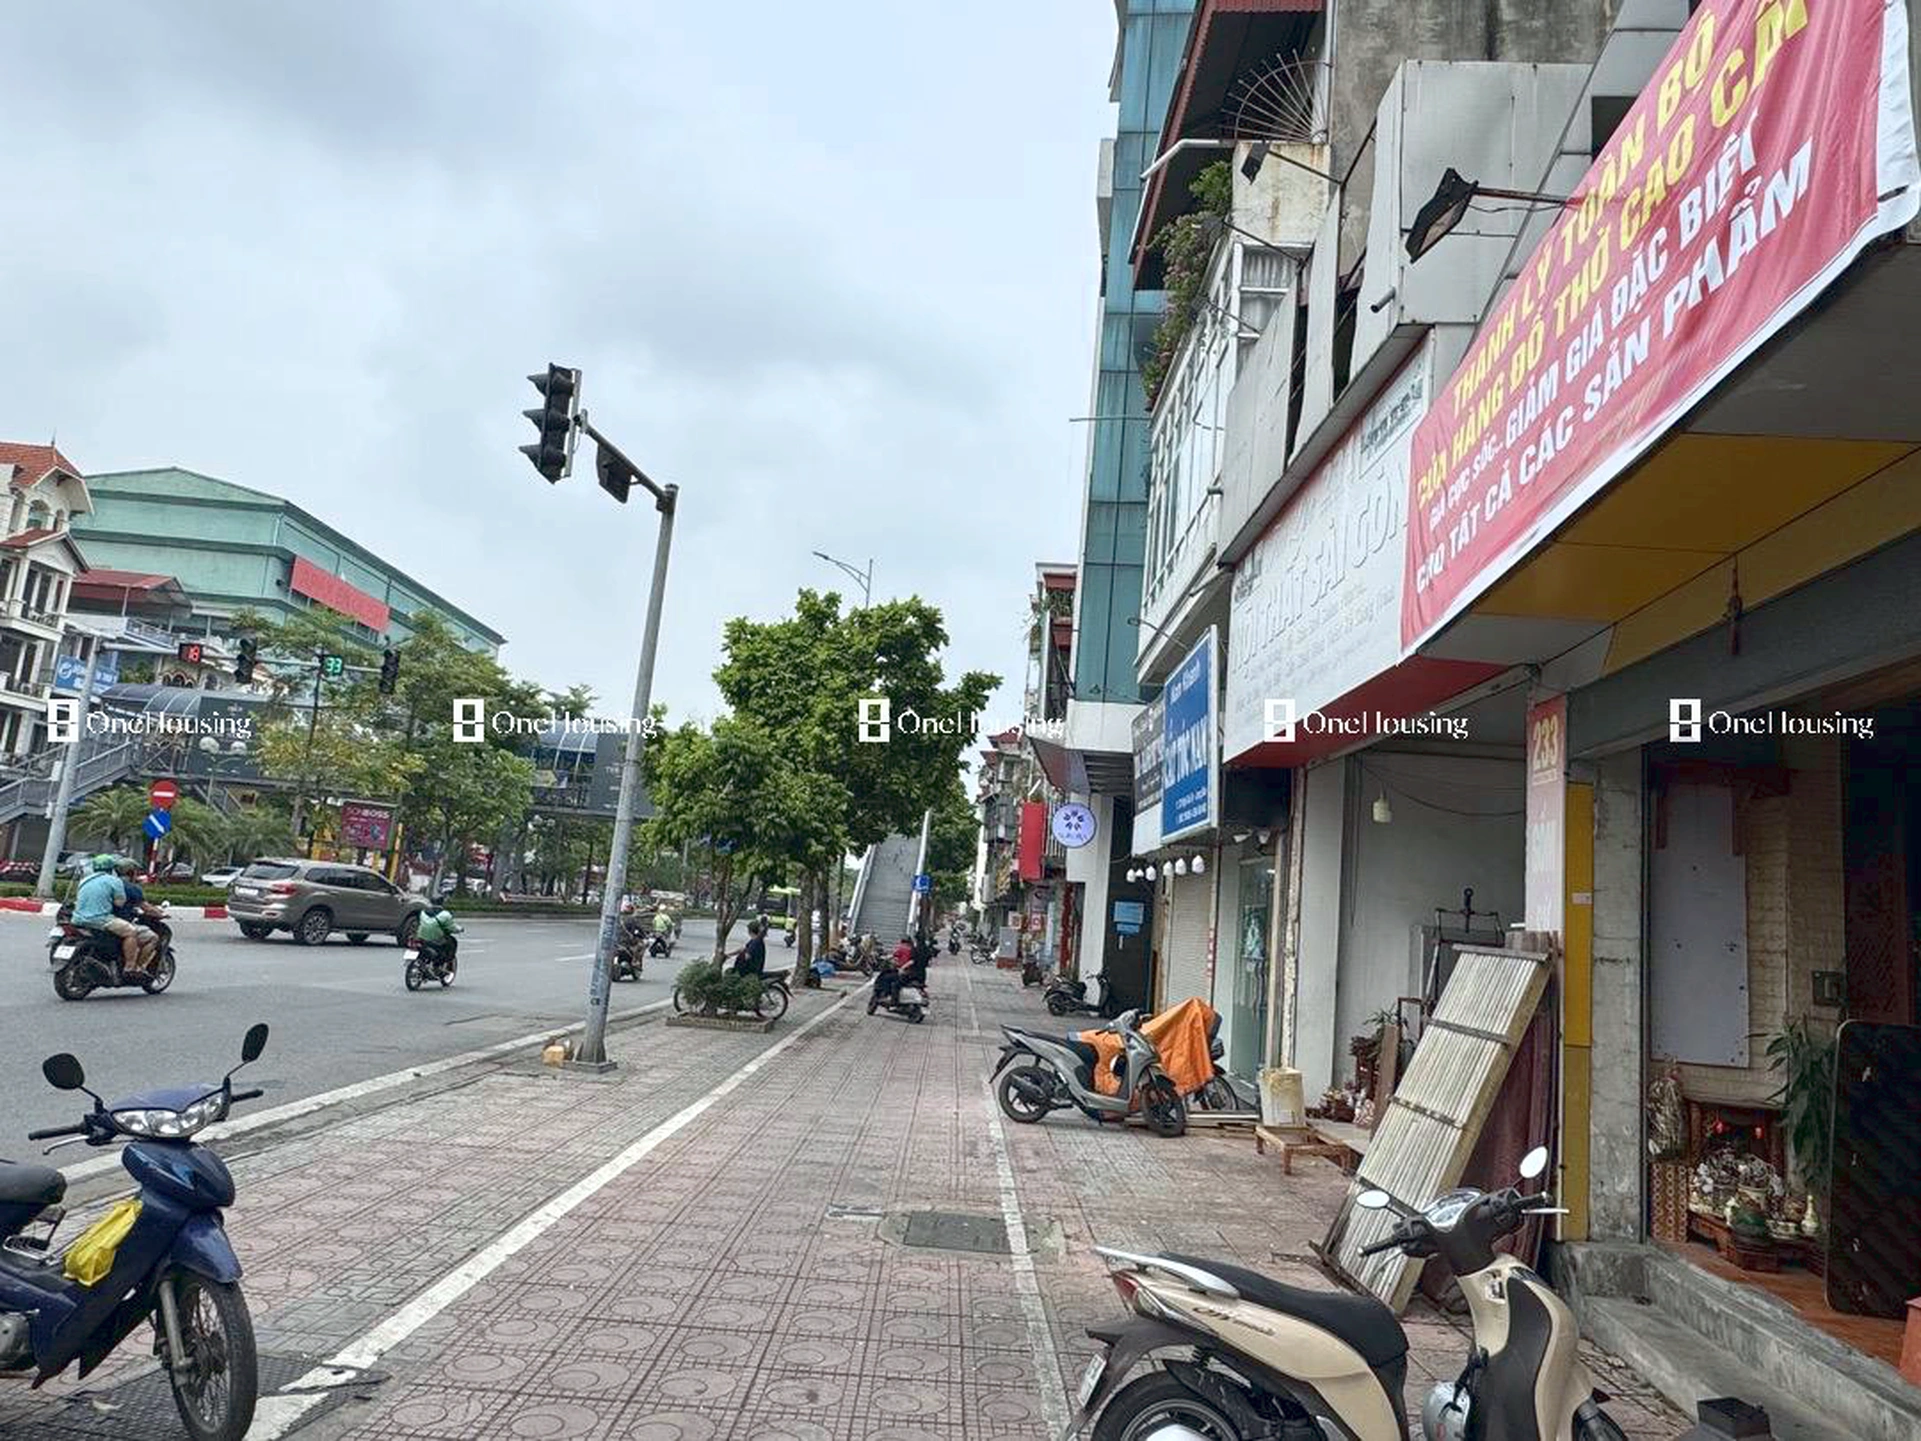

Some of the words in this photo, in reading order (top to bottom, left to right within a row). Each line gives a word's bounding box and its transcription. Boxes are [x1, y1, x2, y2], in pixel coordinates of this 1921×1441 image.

[1449, 501, 1481, 559] TẤT
[1485, 458, 1513, 522] CẢ
[1520, 405, 1575, 484] CÁC
[1583, 315, 1650, 422] SẢN
[1663, 136, 1813, 340] PHẨM
[1452, 372, 1505, 470] HÀNG
[1620, 113, 1696, 250] CAO
[1454, 298, 1517, 419] THANH
[1657, 9, 1715, 137] BỘ
[1505, 359, 1559, 449] GIẢM
[1565, 300, 1604, 383] GIÁ
[1611, 227, 1668, 329] ĐẶC
[326, 657, 342, 673] 33
[1532, 713, 1558, 769] 233
